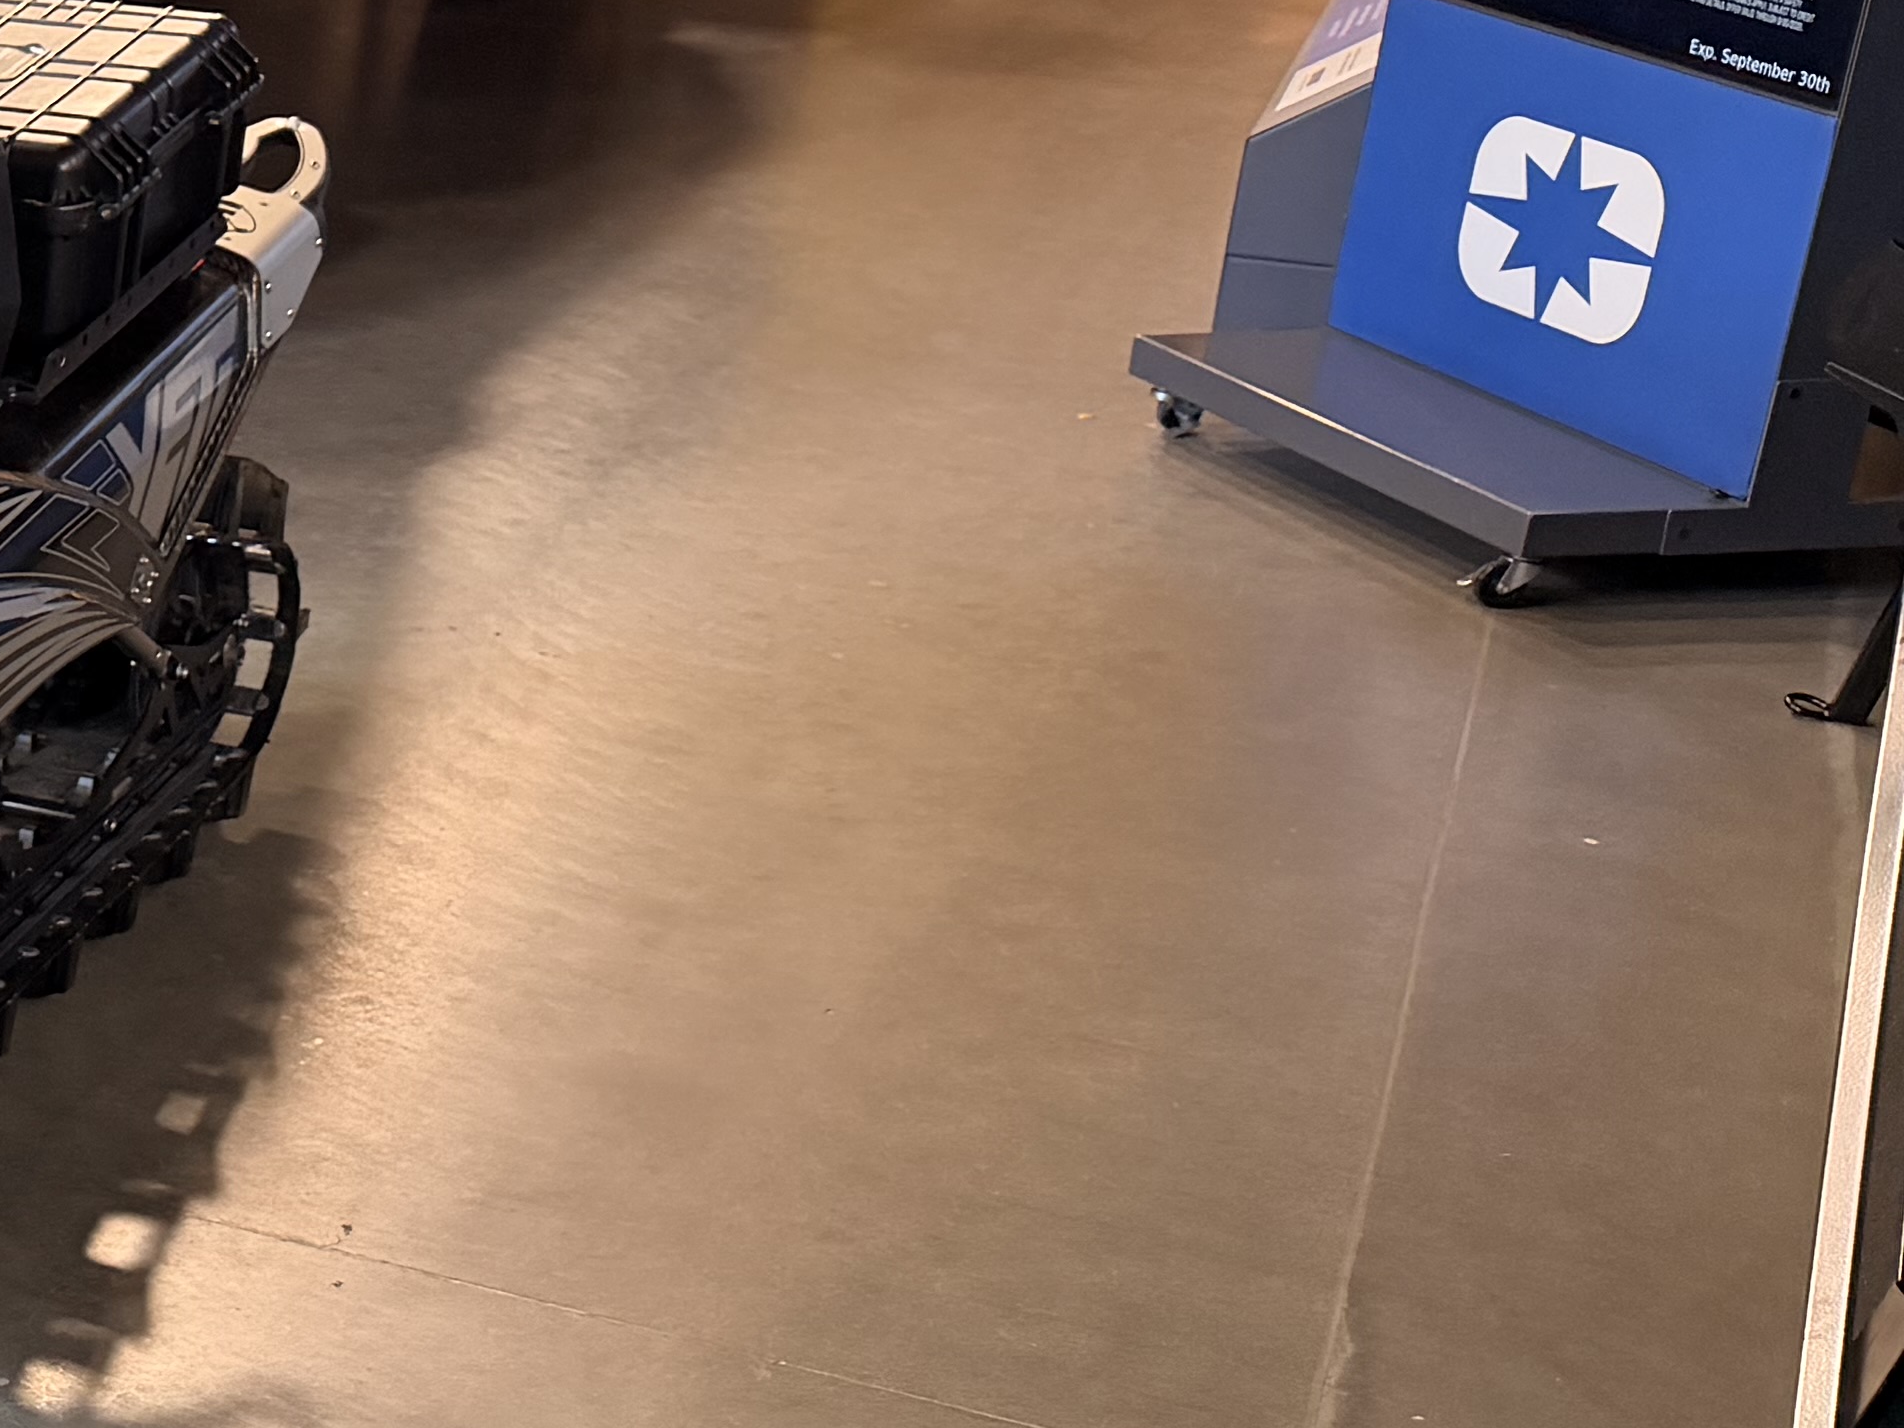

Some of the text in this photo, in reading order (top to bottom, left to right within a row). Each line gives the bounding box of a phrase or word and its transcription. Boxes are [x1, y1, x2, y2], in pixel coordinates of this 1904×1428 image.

[1689, 38, 1831, 94] Exp. September 30th
